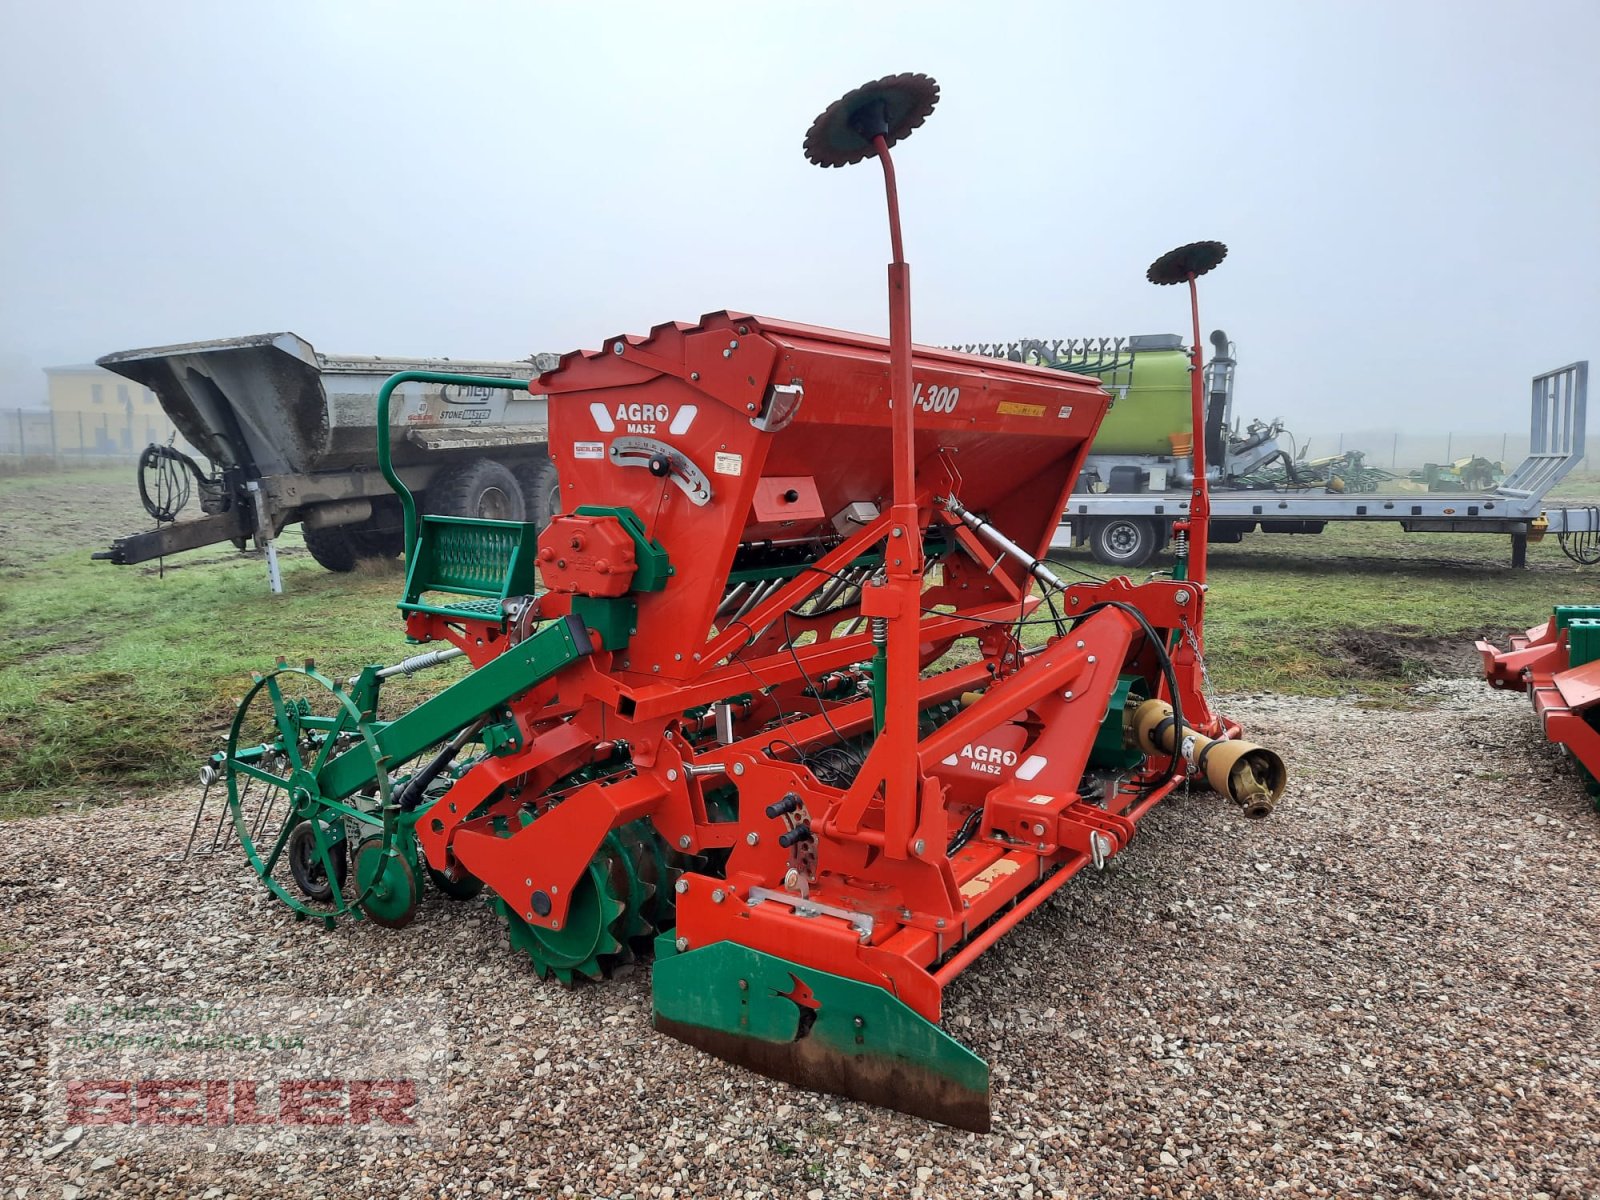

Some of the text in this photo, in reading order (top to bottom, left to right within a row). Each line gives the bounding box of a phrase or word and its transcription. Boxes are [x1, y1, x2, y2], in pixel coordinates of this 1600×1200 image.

[615, 403, 669, 422] AGRO
[627, 423, 656, 434] MASZ
[960, 743, 1018, 767] AGRO
[970, 761, 1002, 775] MASZ
